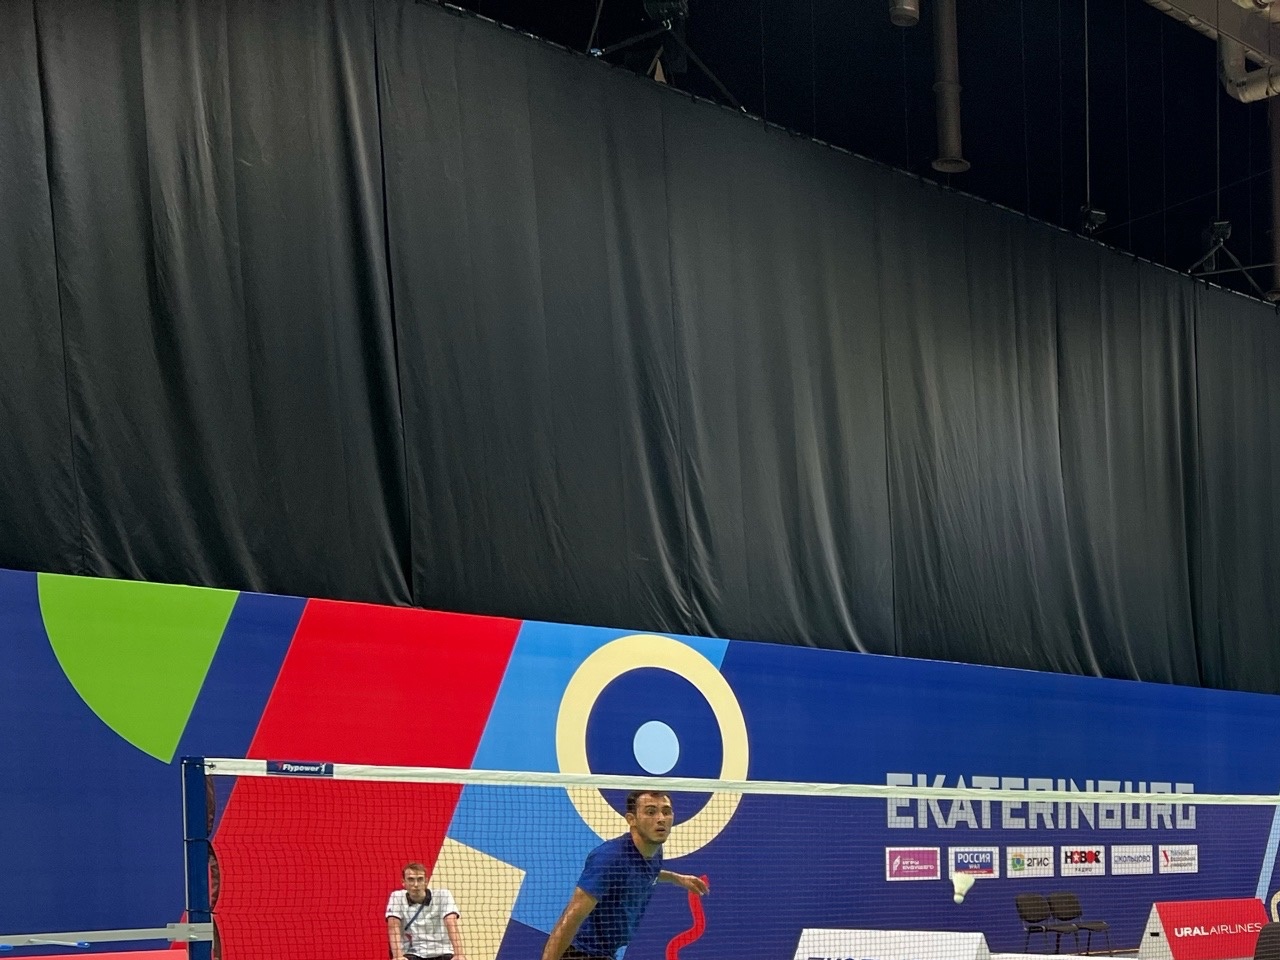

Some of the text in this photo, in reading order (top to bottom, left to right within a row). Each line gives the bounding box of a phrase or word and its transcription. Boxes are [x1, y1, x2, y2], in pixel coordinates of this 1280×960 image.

[282, 763, 320, 772] Flypower
[886, 772, 1197, 830] EKATERINBURG
[957, 853, 991, 864] РОССИЯ
[1026, 857, 1050, 867] 2ГИС
[1174, 922, 1263, 938] URAL AIRLINES
